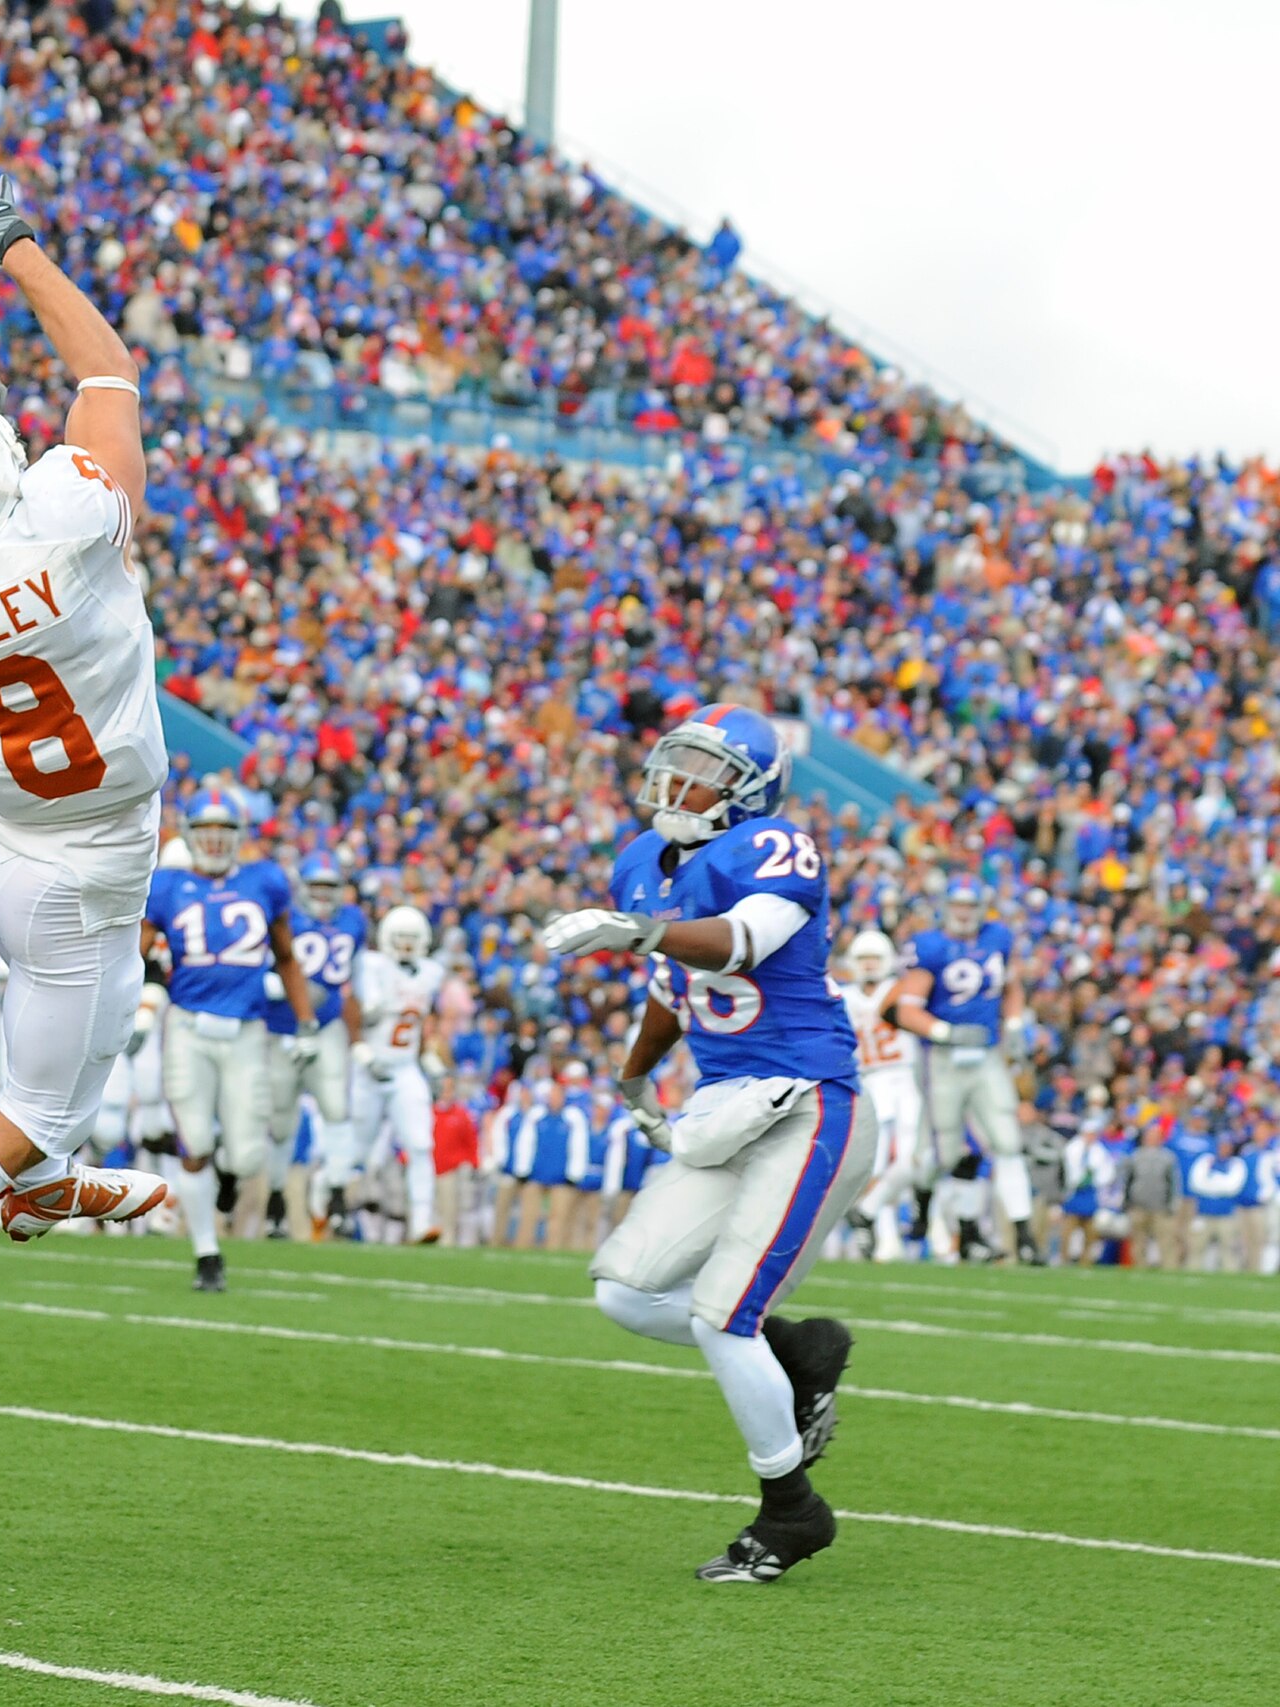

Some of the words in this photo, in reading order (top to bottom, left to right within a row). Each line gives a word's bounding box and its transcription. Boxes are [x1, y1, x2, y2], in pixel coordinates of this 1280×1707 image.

[752, 829, 821, 880] 28
[172, 900, 269, 968] 12
[291, 931, 355, 986] 93
[941, 951, 1006, 1007] 91
